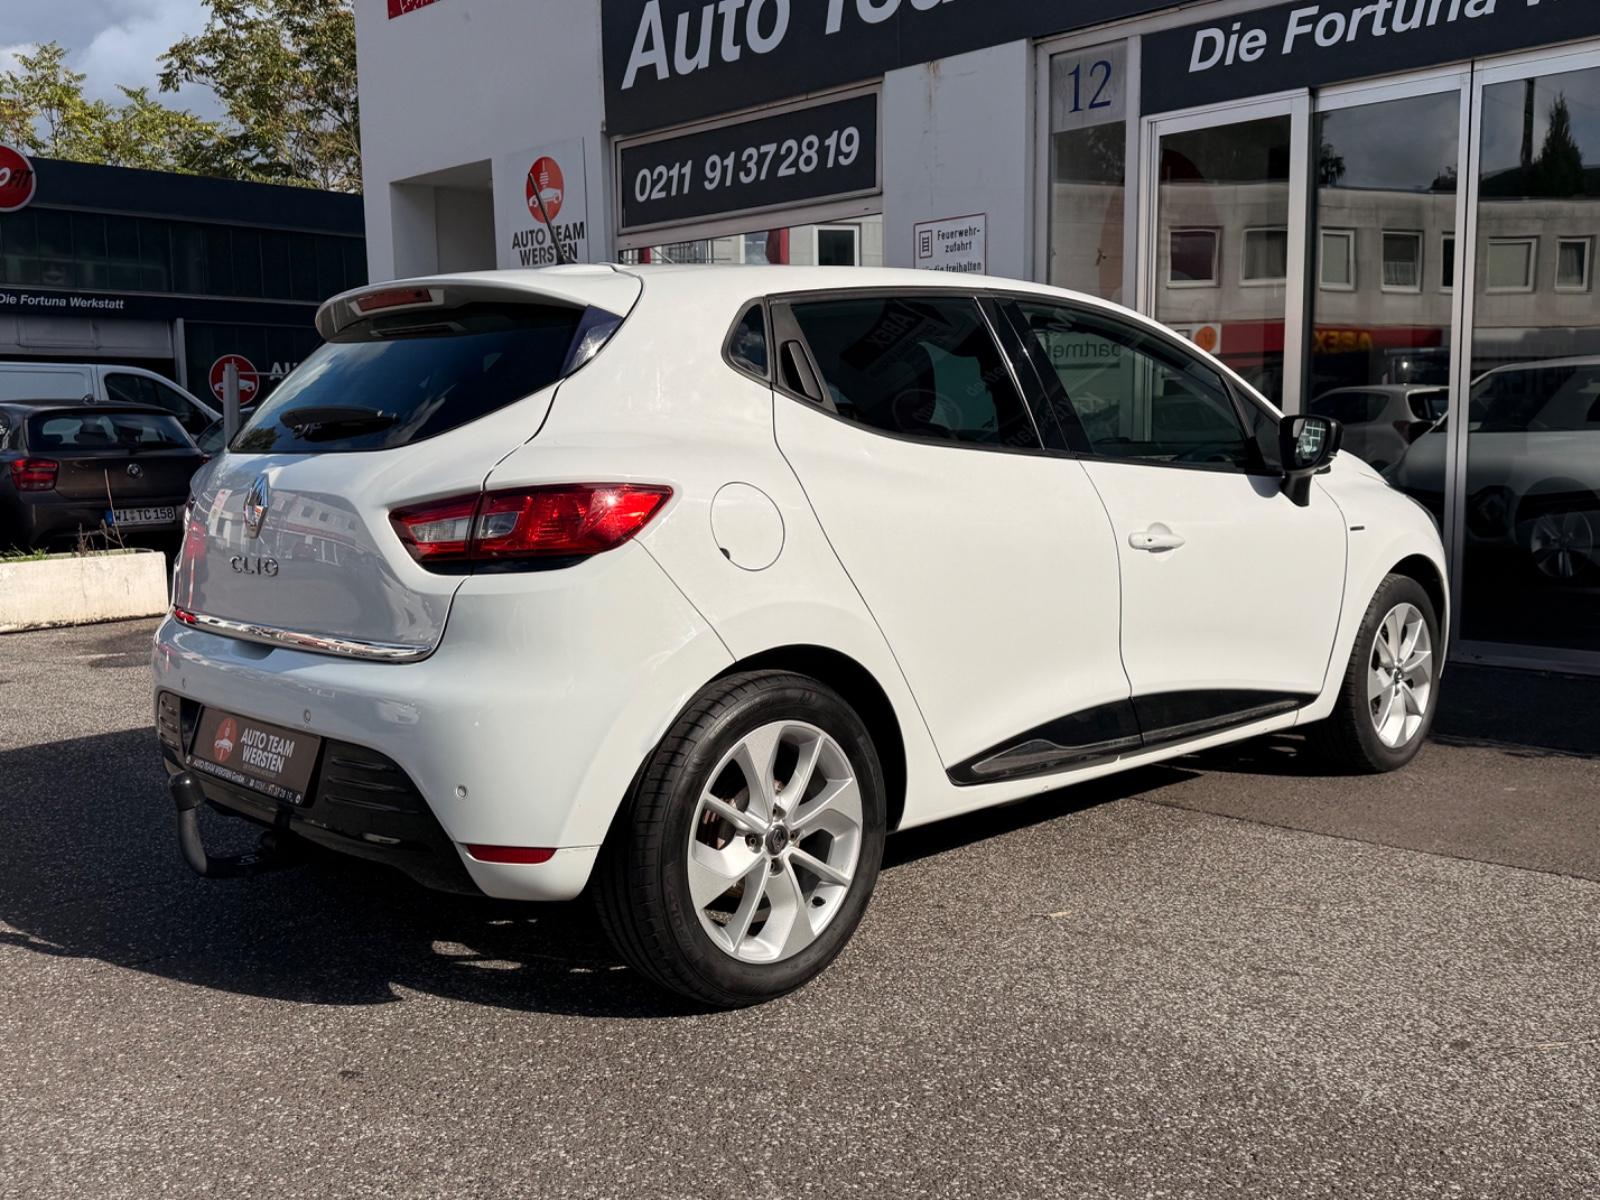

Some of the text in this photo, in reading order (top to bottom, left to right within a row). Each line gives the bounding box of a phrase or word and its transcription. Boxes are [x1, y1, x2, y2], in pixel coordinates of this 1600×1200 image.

[621, 0, 791, 90] Auto
[1188, 0, 1496, 73] Die Fortuna
[1067, 60, 1112, 113] 12
[634, 126, 860, 203] 0211 91372819
[512, 228, 546, 249] AUTO
[937, 226, 981, 241] Feuerwehr-
[945, 240, 973, 253] zufahrt
[520, 241, 578, 267] WERSEN
[20, 294, 66, 307] Fortuna
[70, 297, 124, 309] Werkstatt
[136, 508, 151, 521] TC
[153, 507, 174, 520] 158
[229, 555, 279, 577] CLIO
[241, 728, 295, 758] AUTO TEAM
[242, 745, 285, 773] WERSTEN
